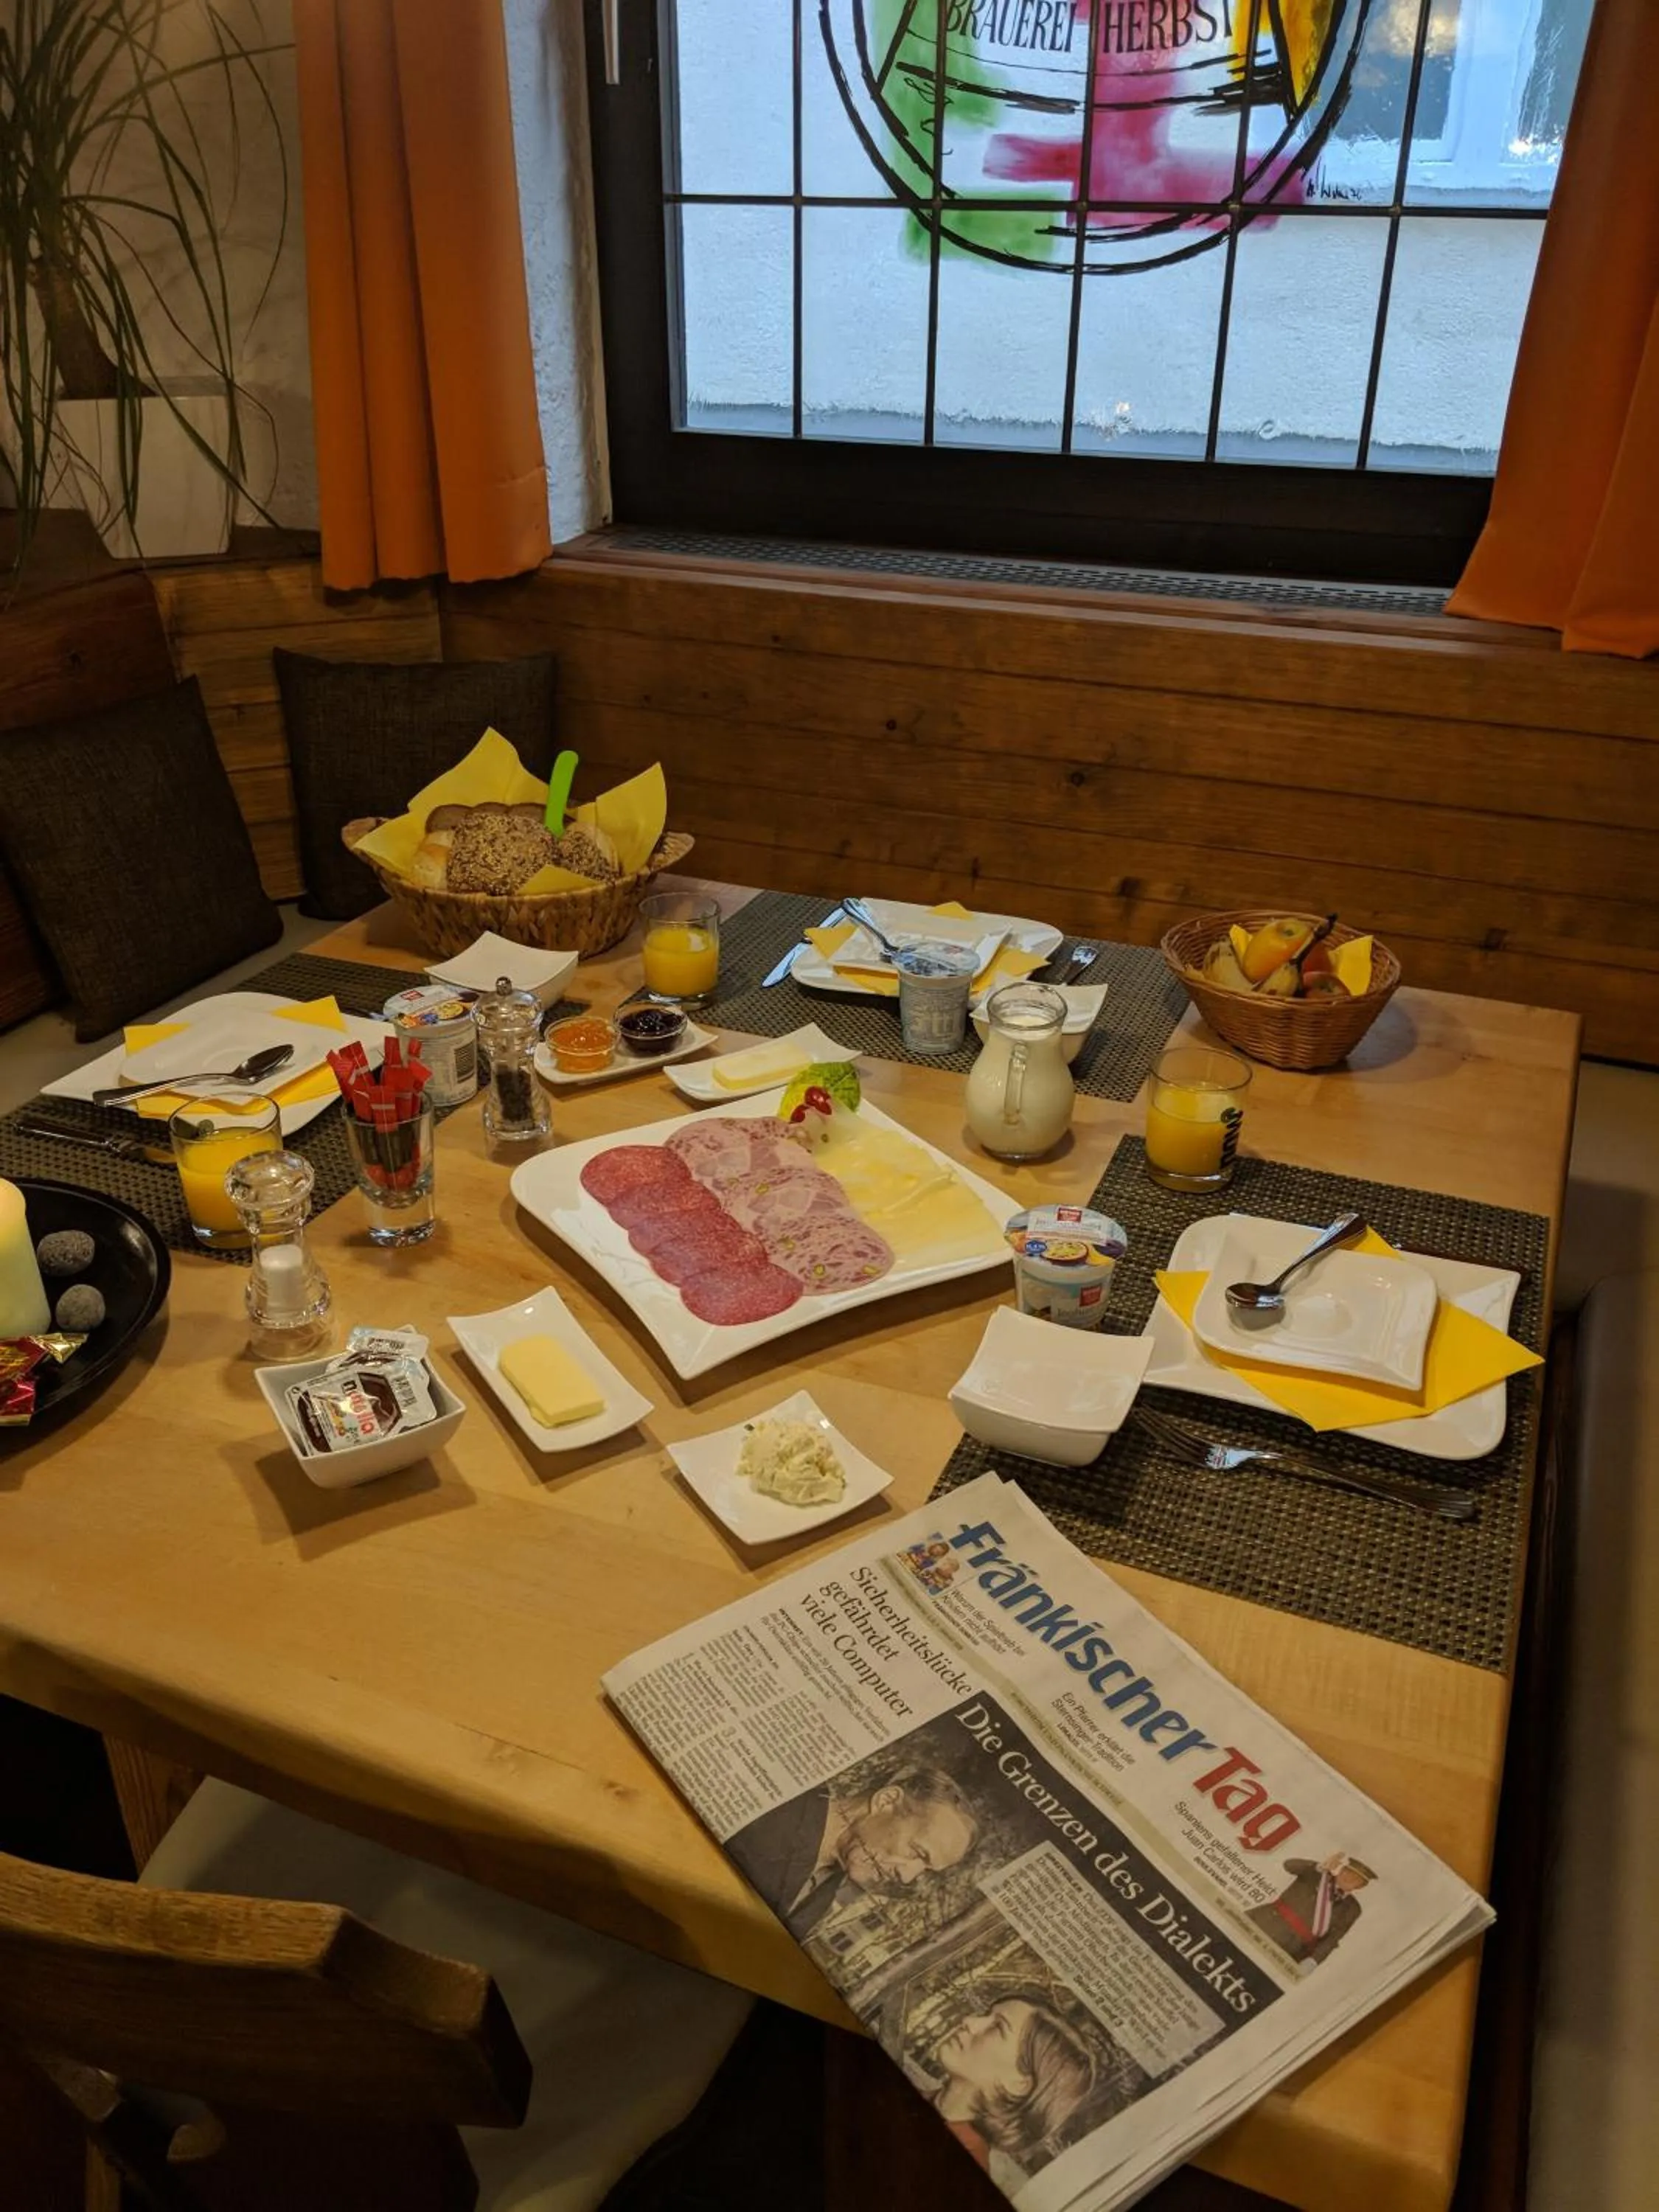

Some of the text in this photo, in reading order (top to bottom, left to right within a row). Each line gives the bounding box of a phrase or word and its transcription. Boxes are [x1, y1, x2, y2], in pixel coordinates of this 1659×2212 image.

[946, 0, 1077, 52] BRAUEREI
[798, 1593, 837, 1635] viele
[836, 1637, 913, 1717] Computer
[818, 1581, 900, 1662] gefährdet
[848, 1565, 973, 1696] Sicherheitslücke
[948, 1521, 1217, 1761] Fränkischer
[1193, 1747, 1303, 1851] Tag
[955, 1703, 1004, 1754] Die
[999, 1751, 1095, 1853] Grenzen
[1092, 1853, 1144, 1901] des
[1135, 1893, 1256, 2014] Dialekts
